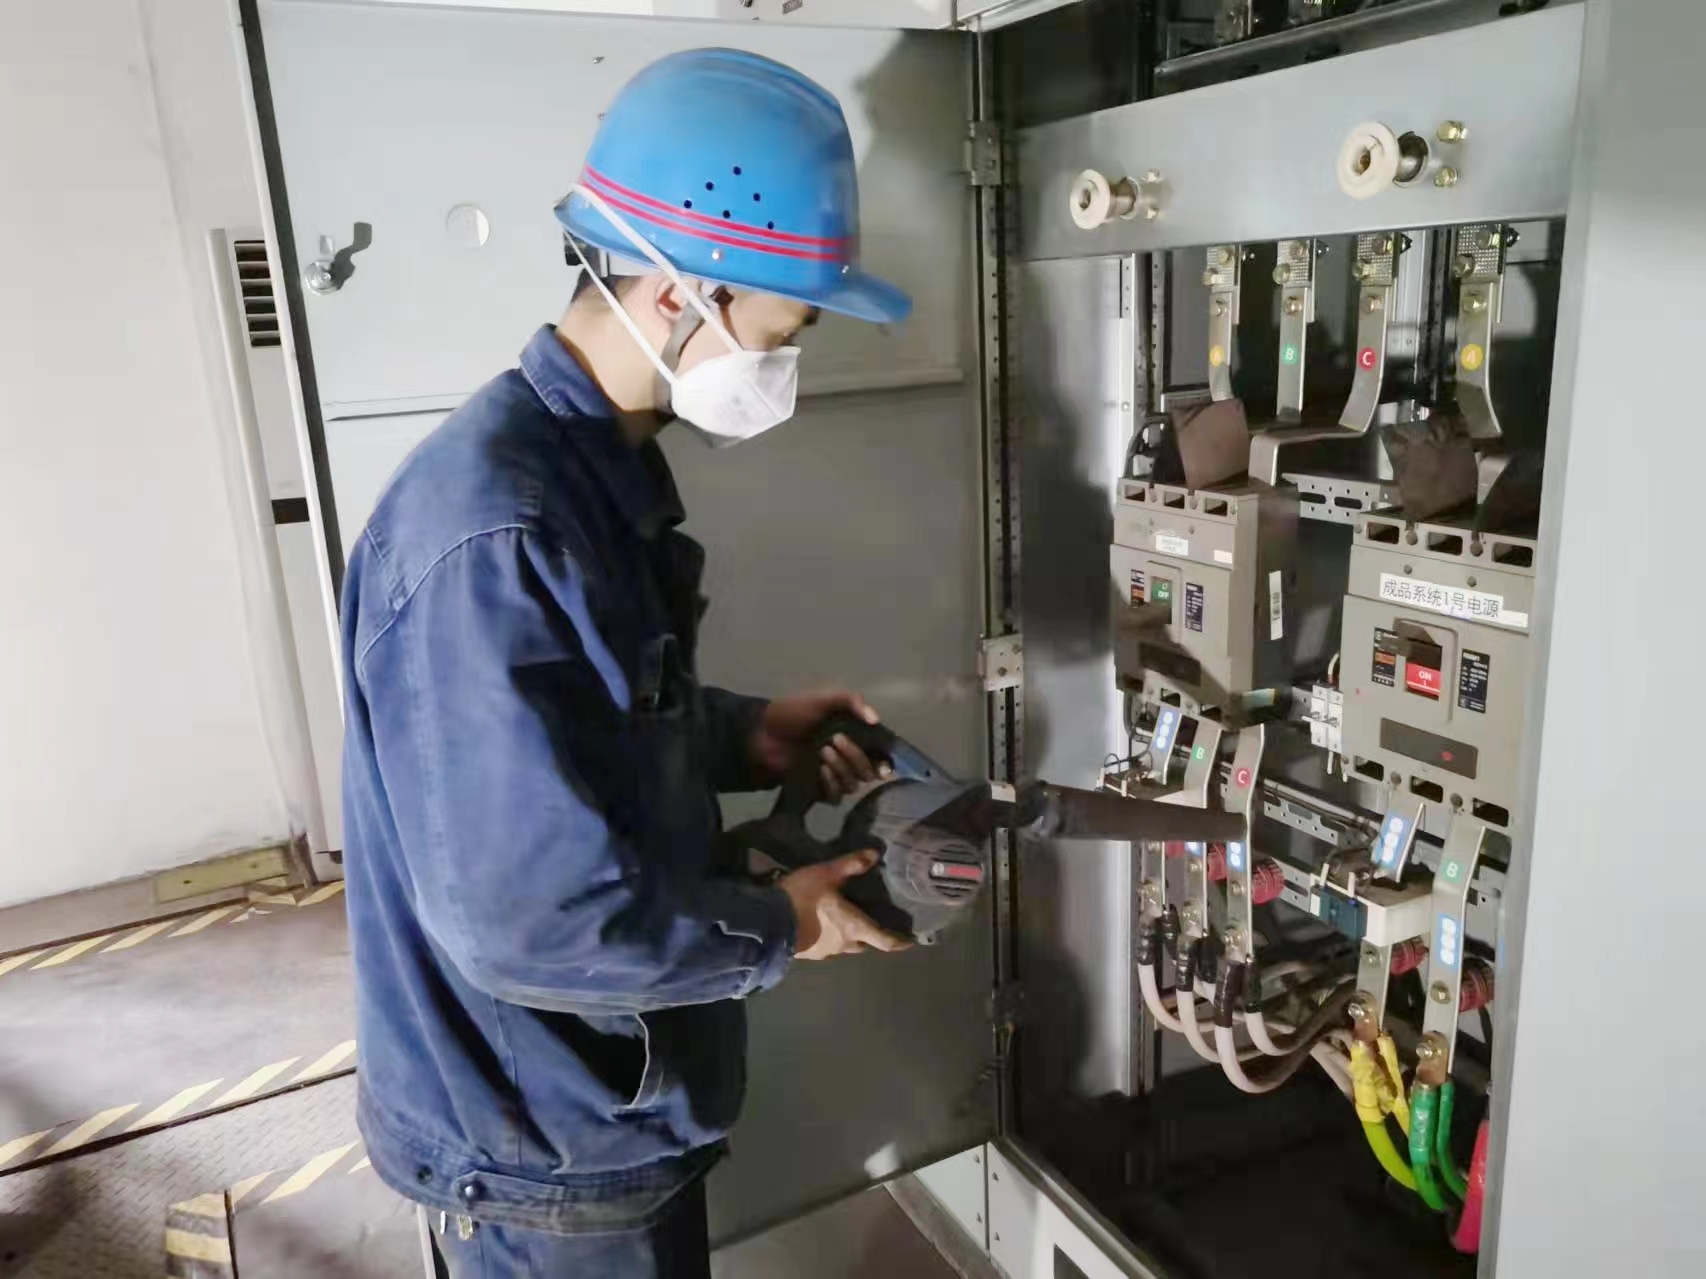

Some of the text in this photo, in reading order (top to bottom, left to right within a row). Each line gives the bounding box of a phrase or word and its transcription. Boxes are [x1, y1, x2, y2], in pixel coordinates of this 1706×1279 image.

[1285, 348, 1293, 360] B
[1362, 351, 1372, 366] C
[1383, 578, 1499, 618] 成品系统1号电源
[1418, 670, 1432, 681] ON
[1195, 747, 1205, 760] B
[1238, 770, 1248, 784] C
[1446, 863, 1458, 878] B
